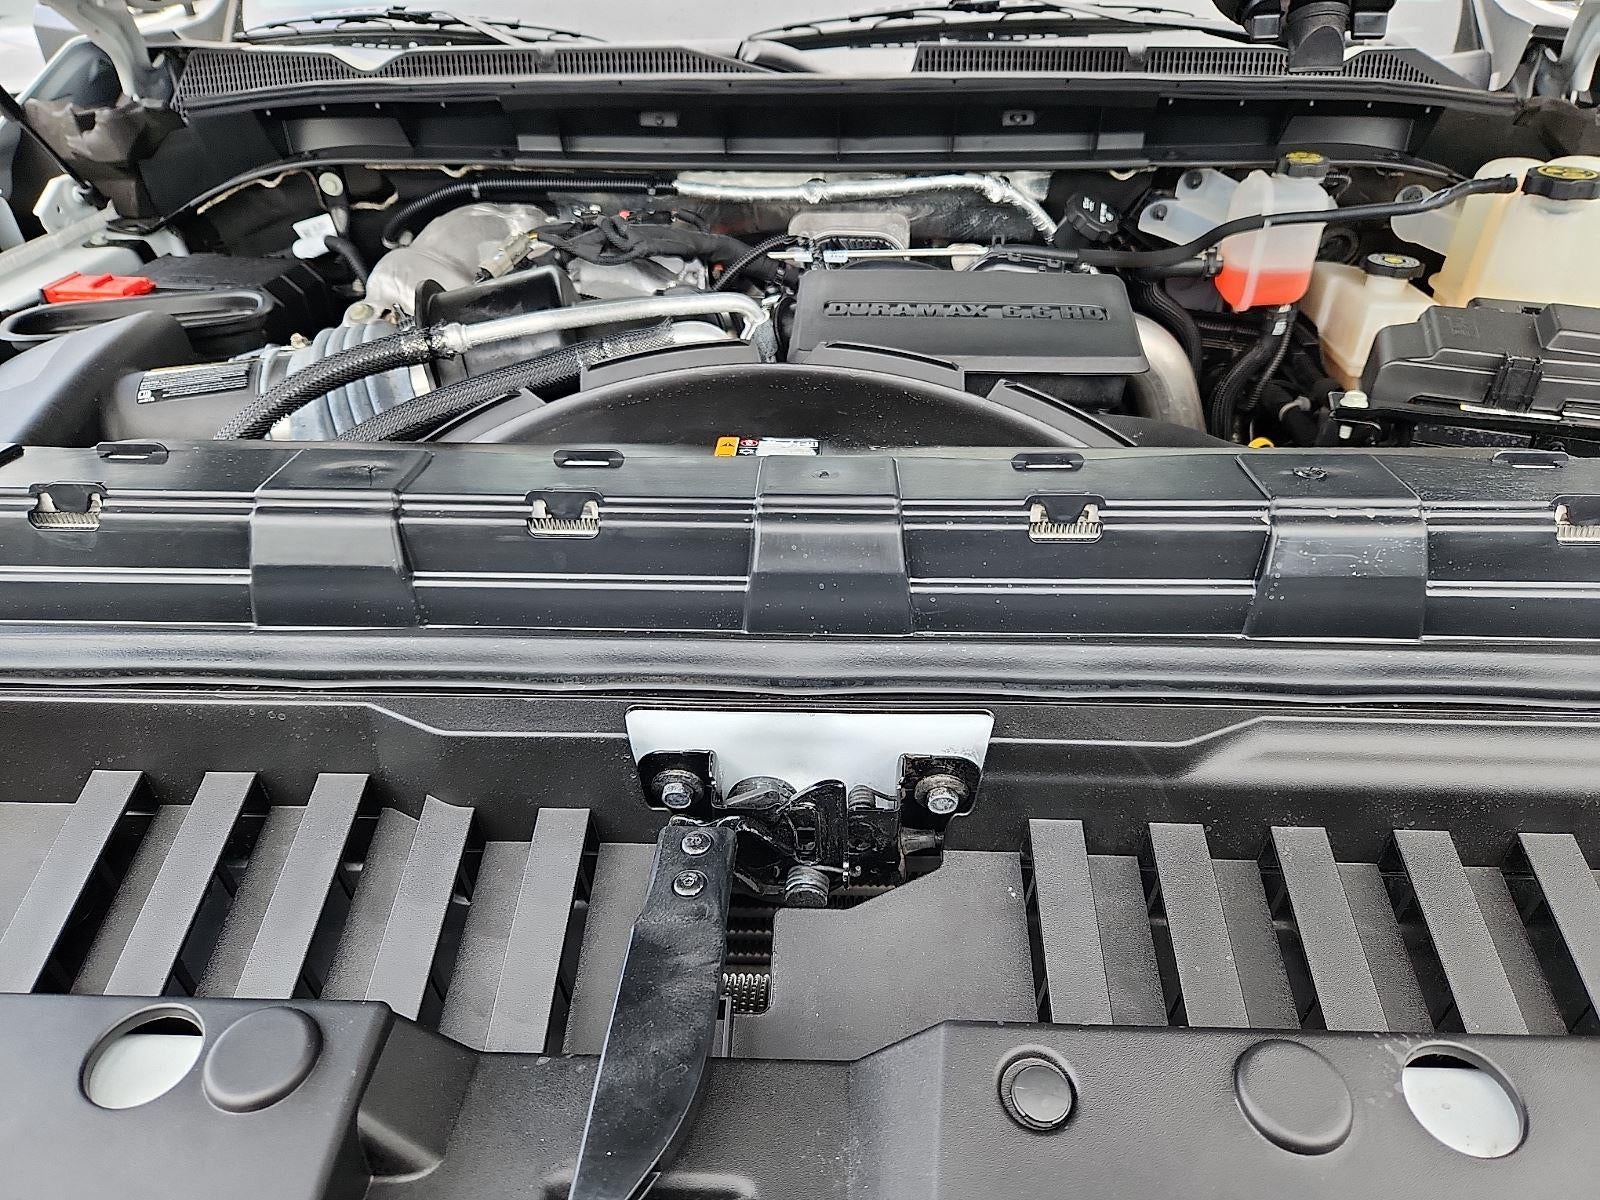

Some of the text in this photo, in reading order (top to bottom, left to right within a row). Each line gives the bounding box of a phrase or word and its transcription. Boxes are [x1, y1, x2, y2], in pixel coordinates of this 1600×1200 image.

[827, 302, 1106, 321] DURAMAX 6.6 HD
